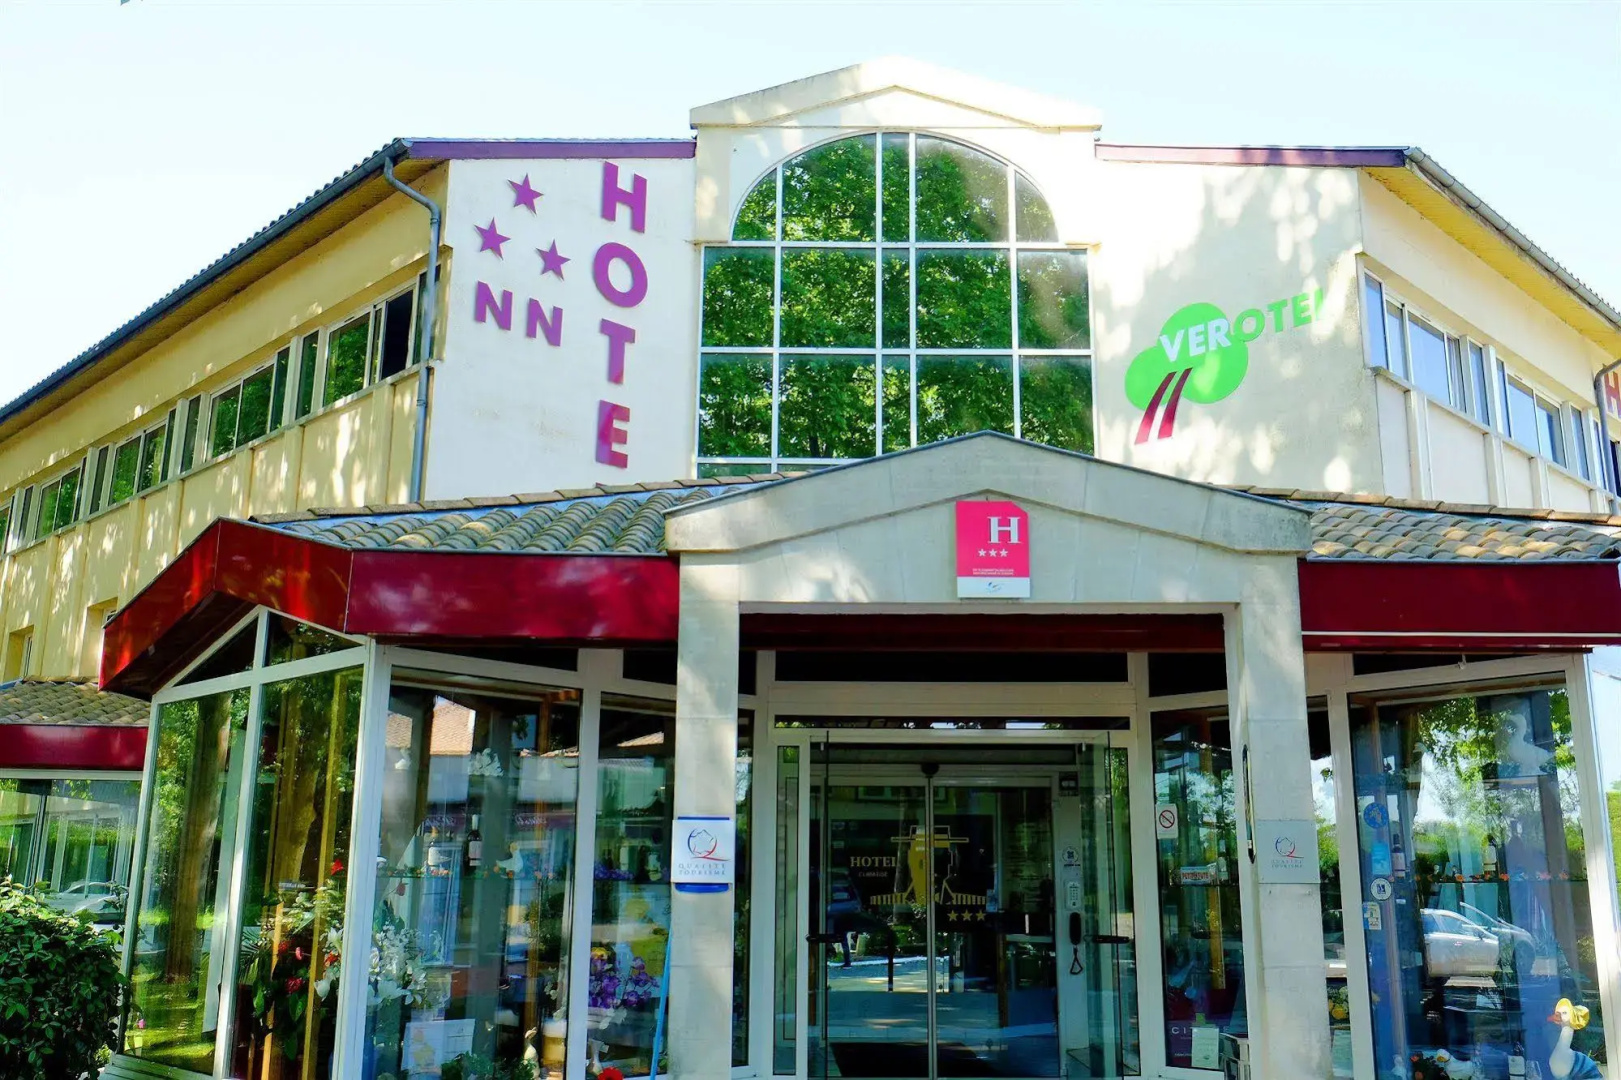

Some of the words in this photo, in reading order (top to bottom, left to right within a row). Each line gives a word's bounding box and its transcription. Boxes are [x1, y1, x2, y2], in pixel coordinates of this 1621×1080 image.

[474, 280, 563, 347] NN
[593, 160, 648, 488] HOTE
[987, 516, 1021, 544] H
[850, 856, 898, 867] HOTEL
